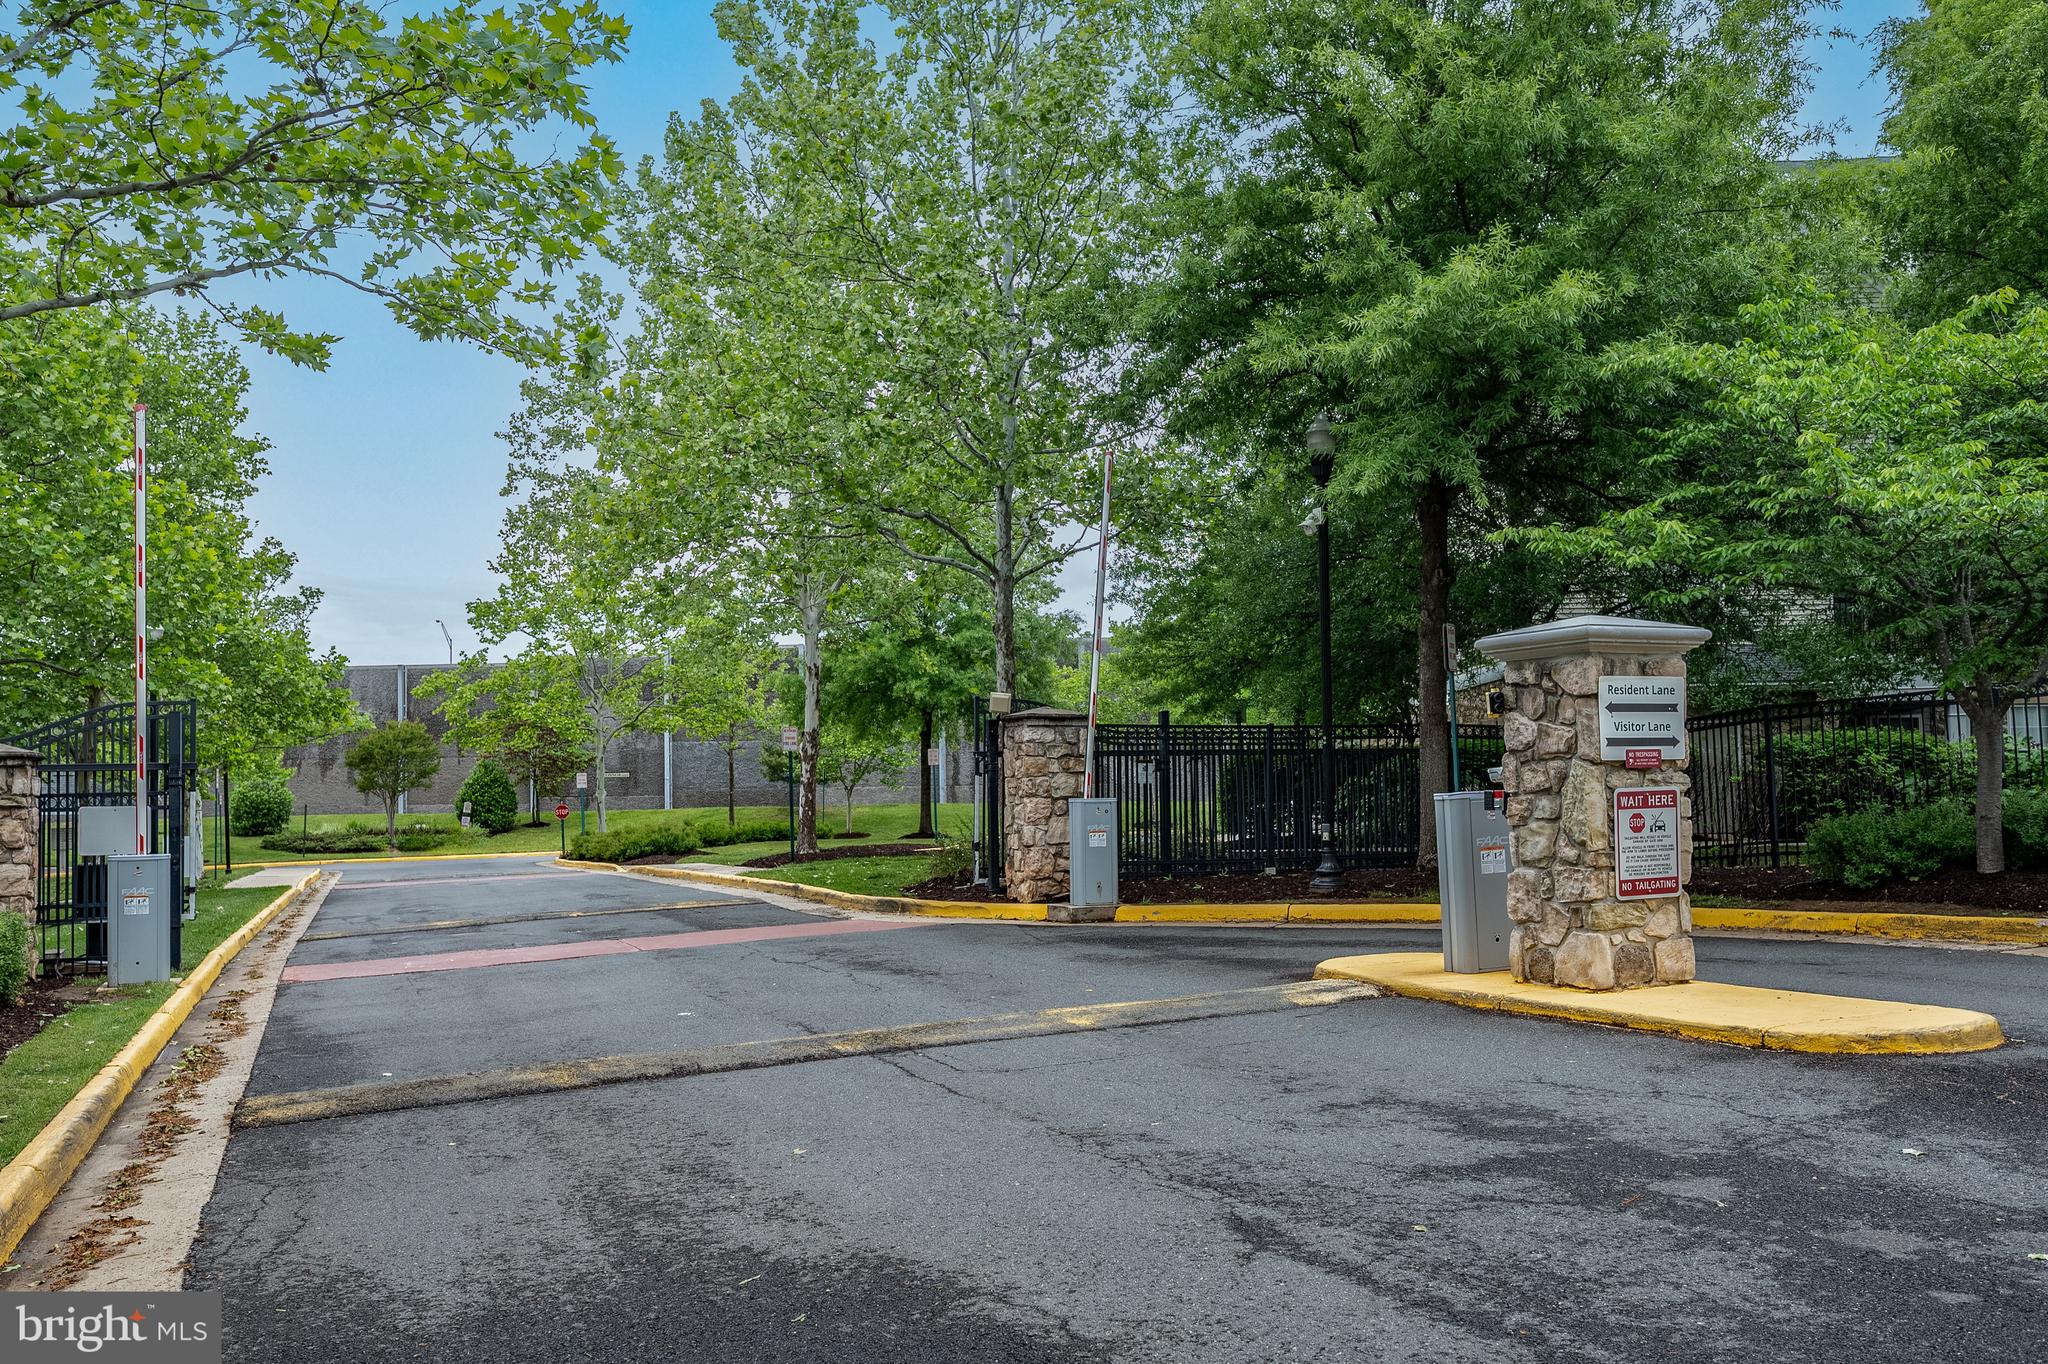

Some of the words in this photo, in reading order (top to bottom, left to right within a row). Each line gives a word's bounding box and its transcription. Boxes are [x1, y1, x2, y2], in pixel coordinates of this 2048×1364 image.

[1607, 684, 1649, 695] Resident
[1652, 685, 1676, 695] Lane
[1613, 721, 1646, 732] Visitor
[1648, 722, 1671, 732] Lane
[1620, 795, 1644, 807] WAIT
[1648, 794, 1674, 806] HERE
[1629, 817, 1645, 828] STOP
[1476, 835, 1508, 847] FAAC
[1622, 882, 1632, 891] NO
[1635, 879, 1676, 890] TAILGATING
[121, 887, 154, 896] FAAC
